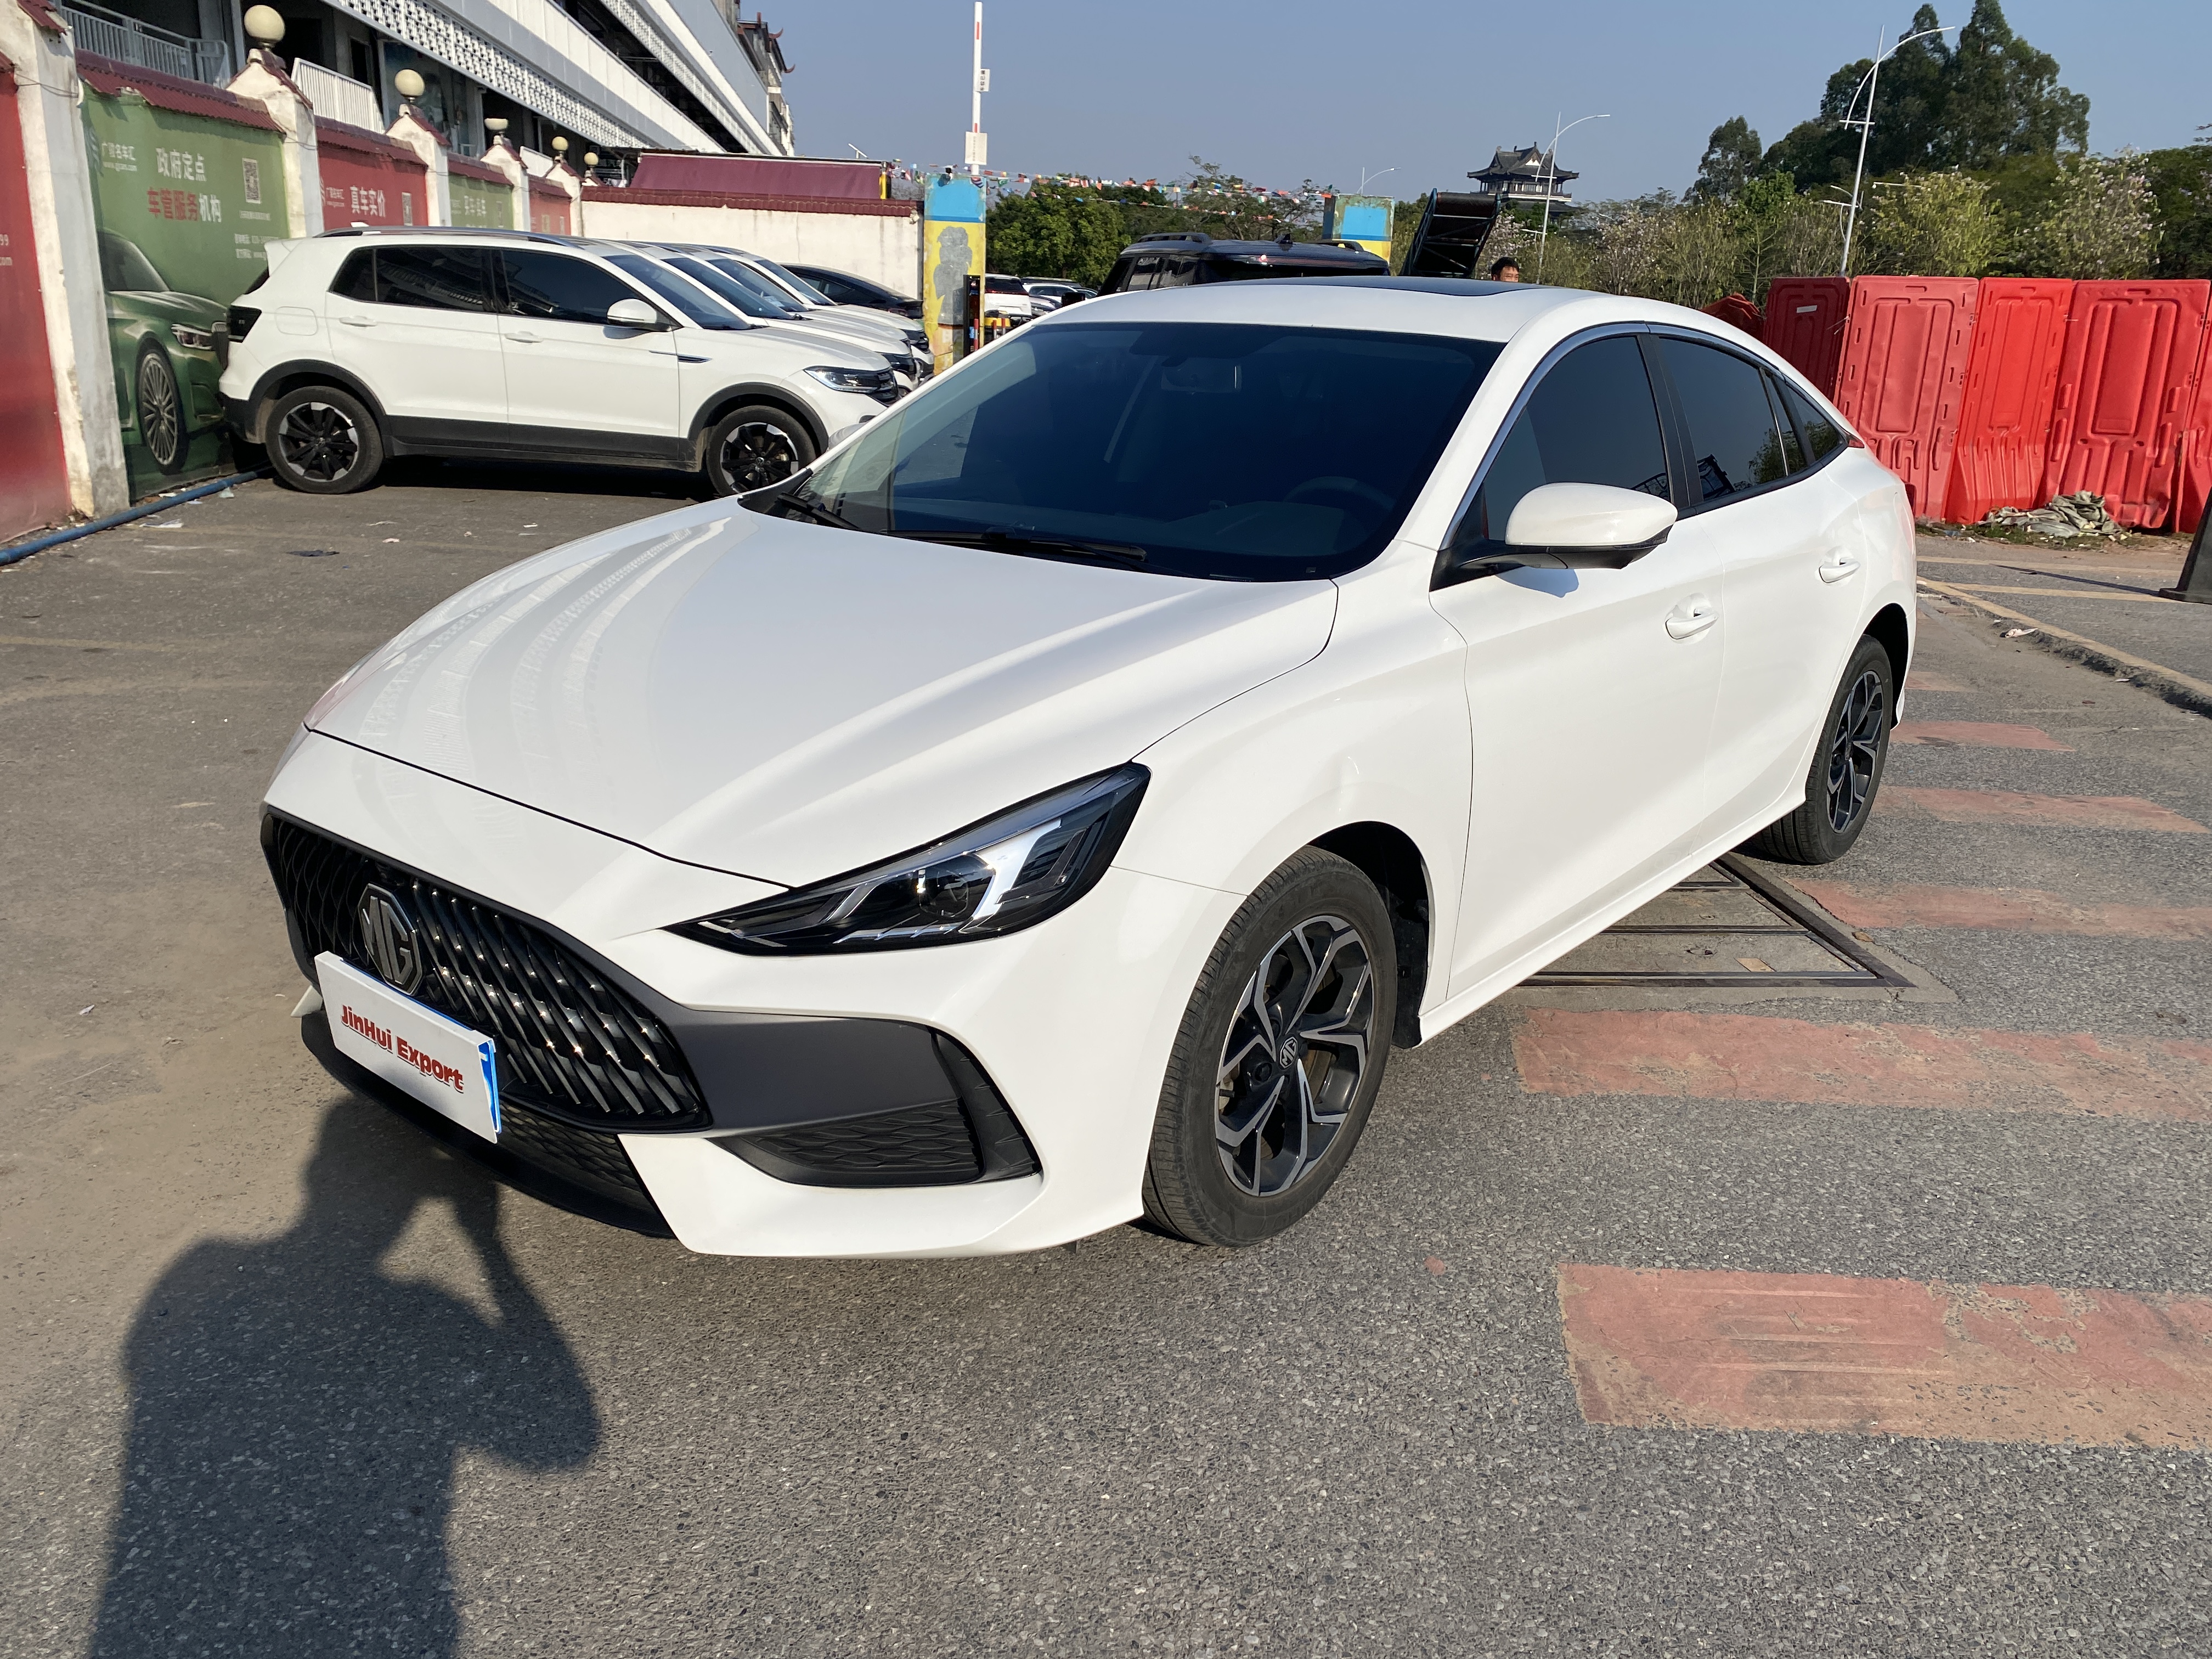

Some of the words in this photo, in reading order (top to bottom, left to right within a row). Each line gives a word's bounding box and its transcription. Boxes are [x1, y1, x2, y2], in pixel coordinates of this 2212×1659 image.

[156, 148, 207, 182] 政府定点
[146, 187, 221, 222] 车管服务机构
[350, 185, 386, 217] 真车实价
[361, 895, 413, 985] MG
[341, 1005, 393, 1054] JinHui
[396, 1035, 464, 1094] Export
[1282, 1040, 1296, 1065] MG
